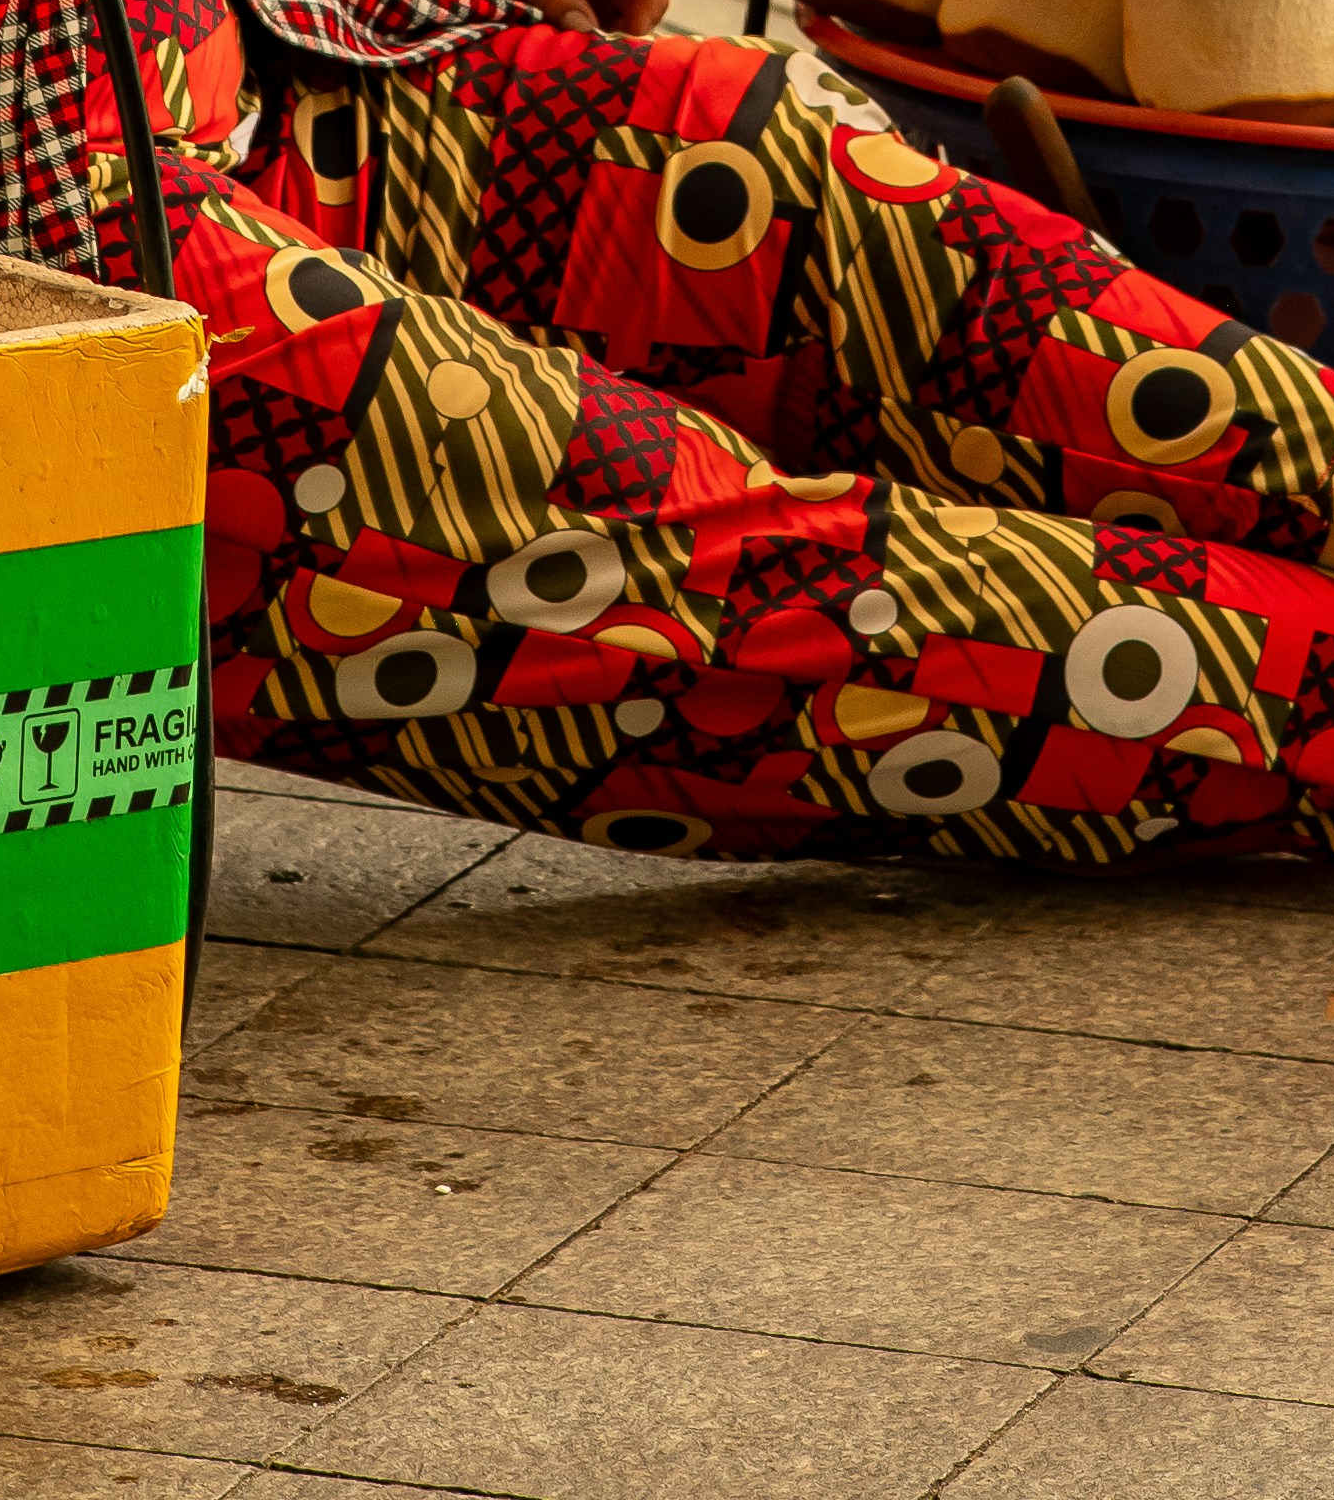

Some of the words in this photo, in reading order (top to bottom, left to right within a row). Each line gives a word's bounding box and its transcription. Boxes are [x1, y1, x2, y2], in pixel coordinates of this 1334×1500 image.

[94, 704, 196, 753] FRAGIL
[93, 755, 140, 777] HAND
[145, 747, 185, 769] WITH
